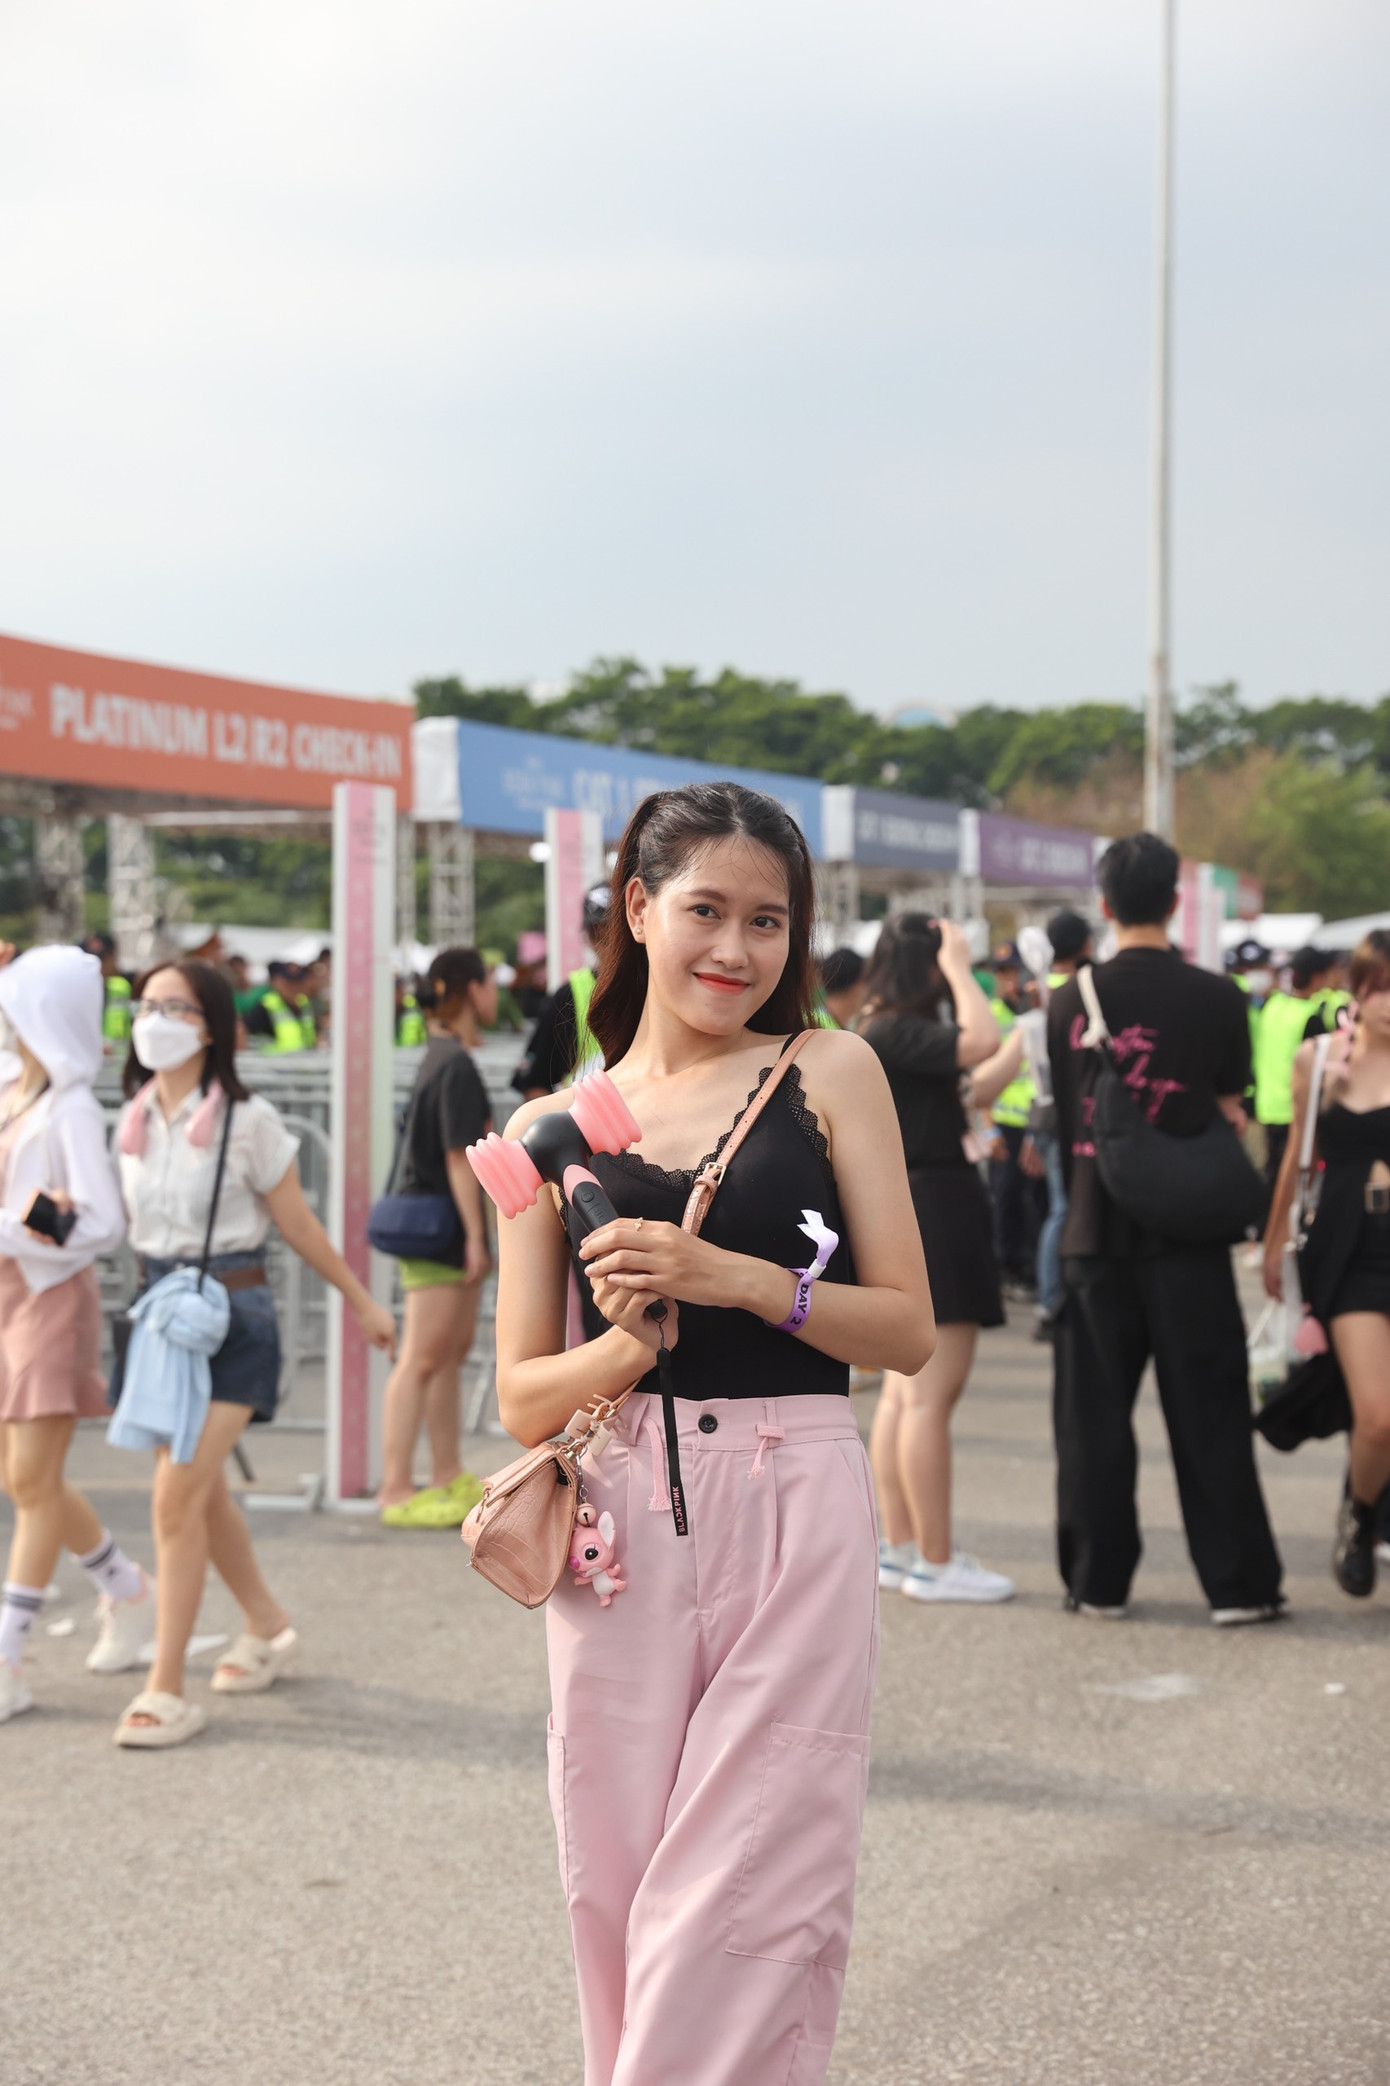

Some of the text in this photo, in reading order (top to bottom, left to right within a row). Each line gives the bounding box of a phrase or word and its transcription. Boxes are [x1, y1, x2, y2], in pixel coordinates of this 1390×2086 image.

[51, 681, 206, 760] PLATINUM
[293, 721, 402, 779] CHECK-IN
[796, 1283, 810, 1314] DAY
[790, 1316, 802, 1326] 2
[672, 1486, 686, 1533] BLACKPINK
